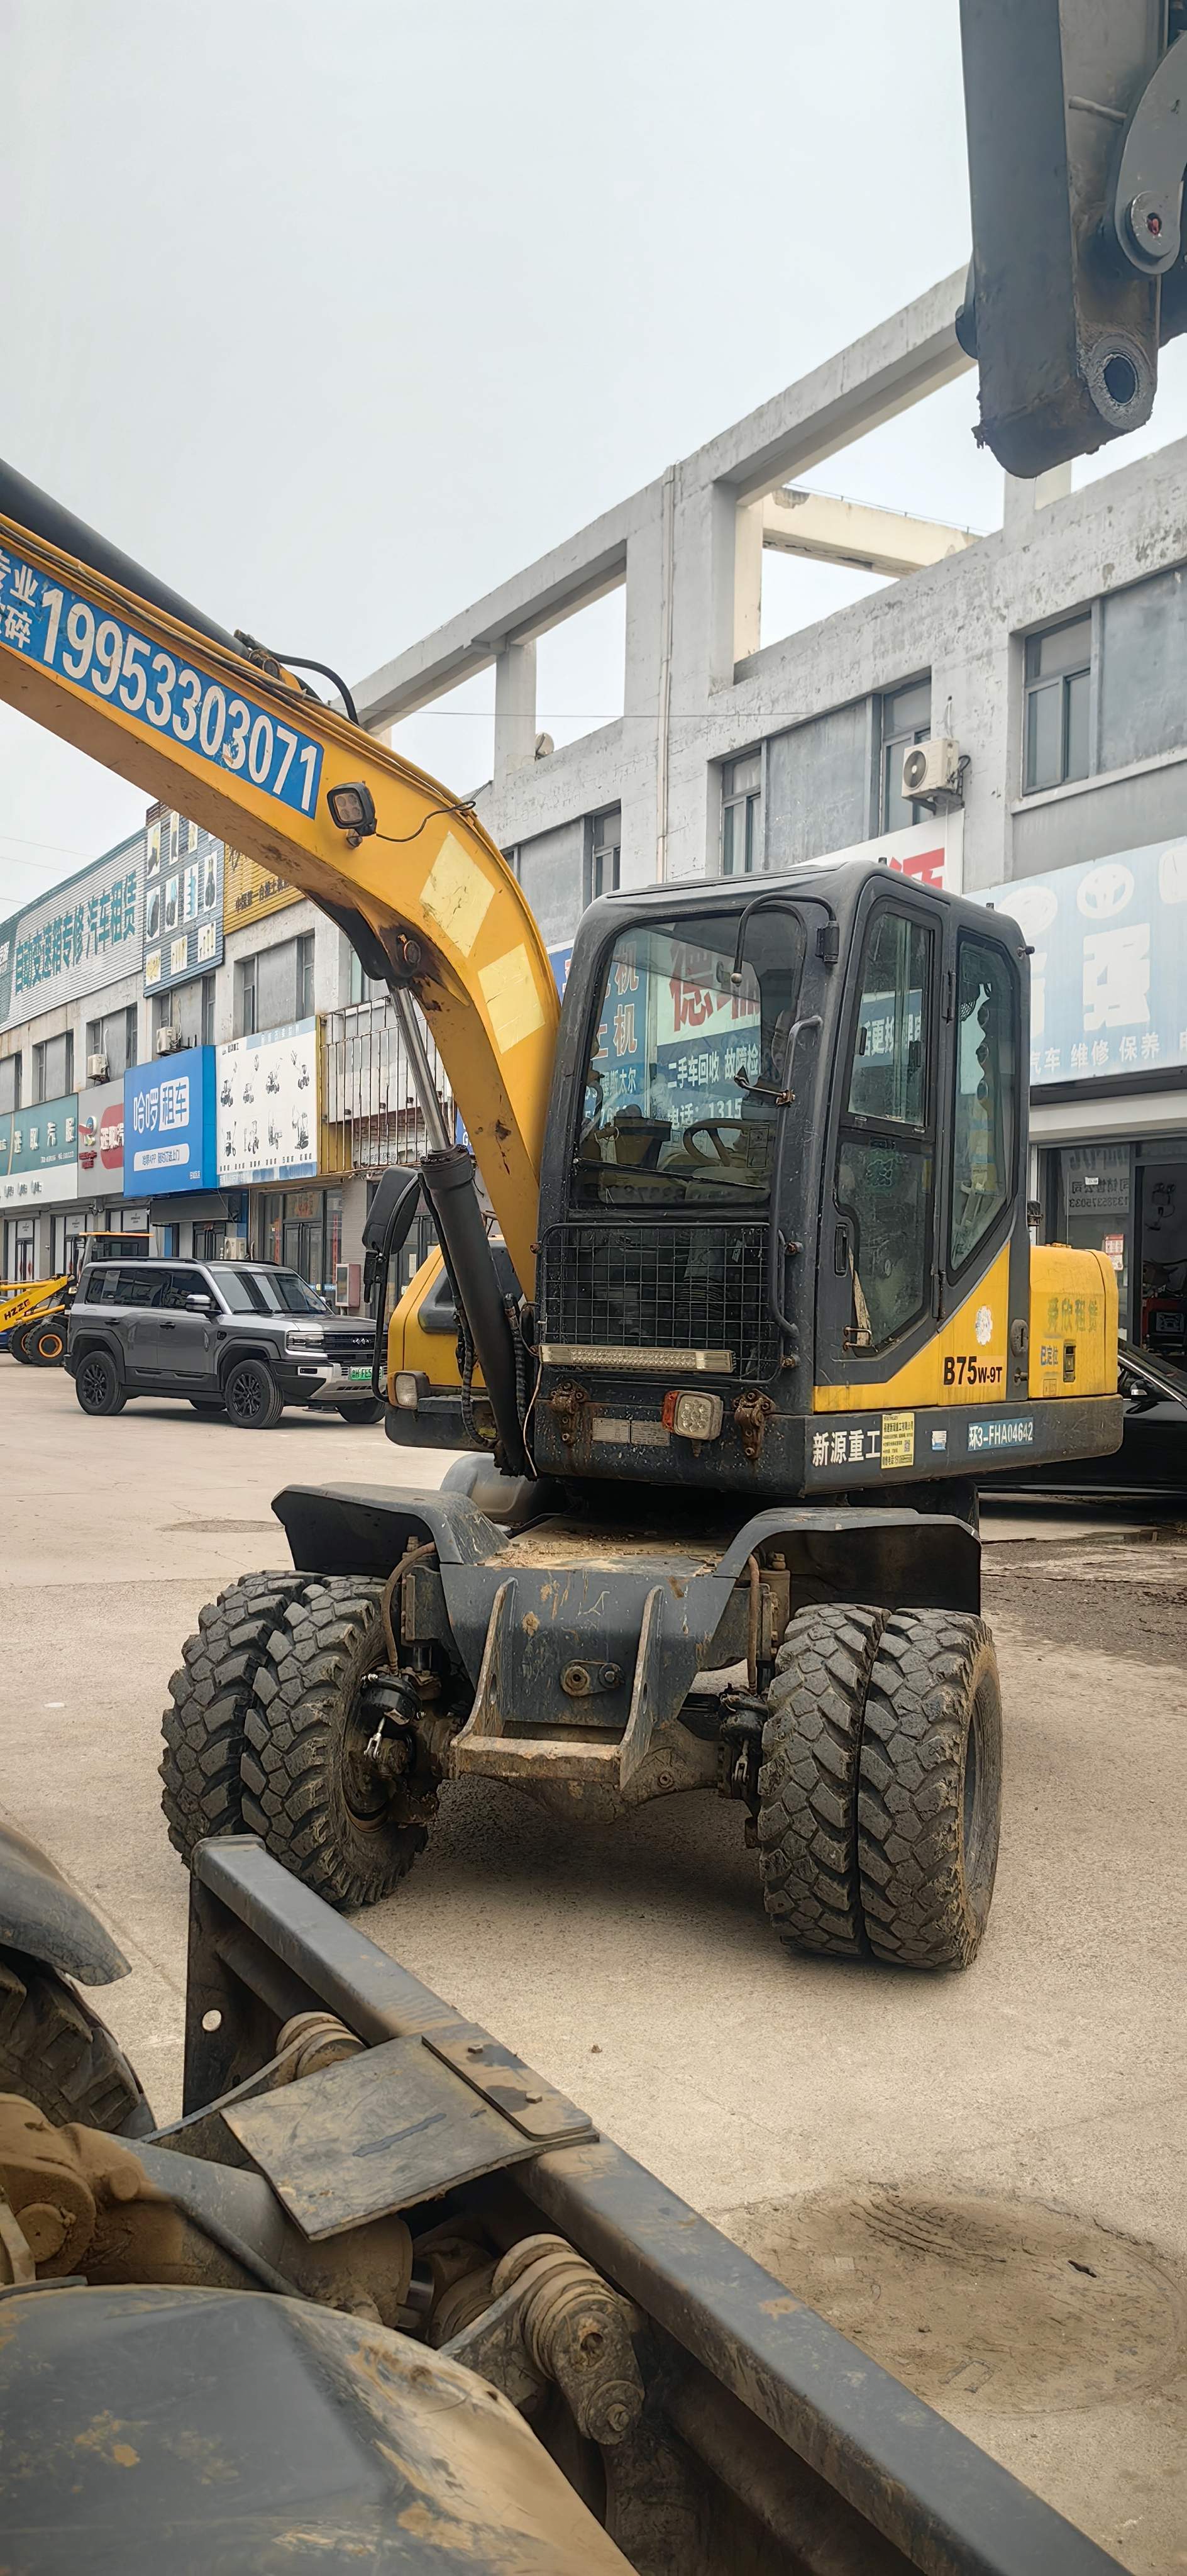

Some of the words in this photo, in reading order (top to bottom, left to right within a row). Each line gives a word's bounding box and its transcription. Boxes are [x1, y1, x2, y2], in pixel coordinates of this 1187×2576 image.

[0, 602, 32, 649] 碎
[41, 589, 317, 811] 19953303071
[668, 1051, 719, 1089] 二手车回收
[725, 1043, 761, 1080] 故障检
[1071, 1039, 1109, 1069] 维修
[1119, 1031, 1160, 1063] 保养
[134, 1082, 187, 1134] 哈啰租车
[943, 1355, 1003, 1385] B75W-9T
[812, 1429, 880, 1467] 新源重工
[969, 1421, 1033, 1450] 环3-FHA04642
